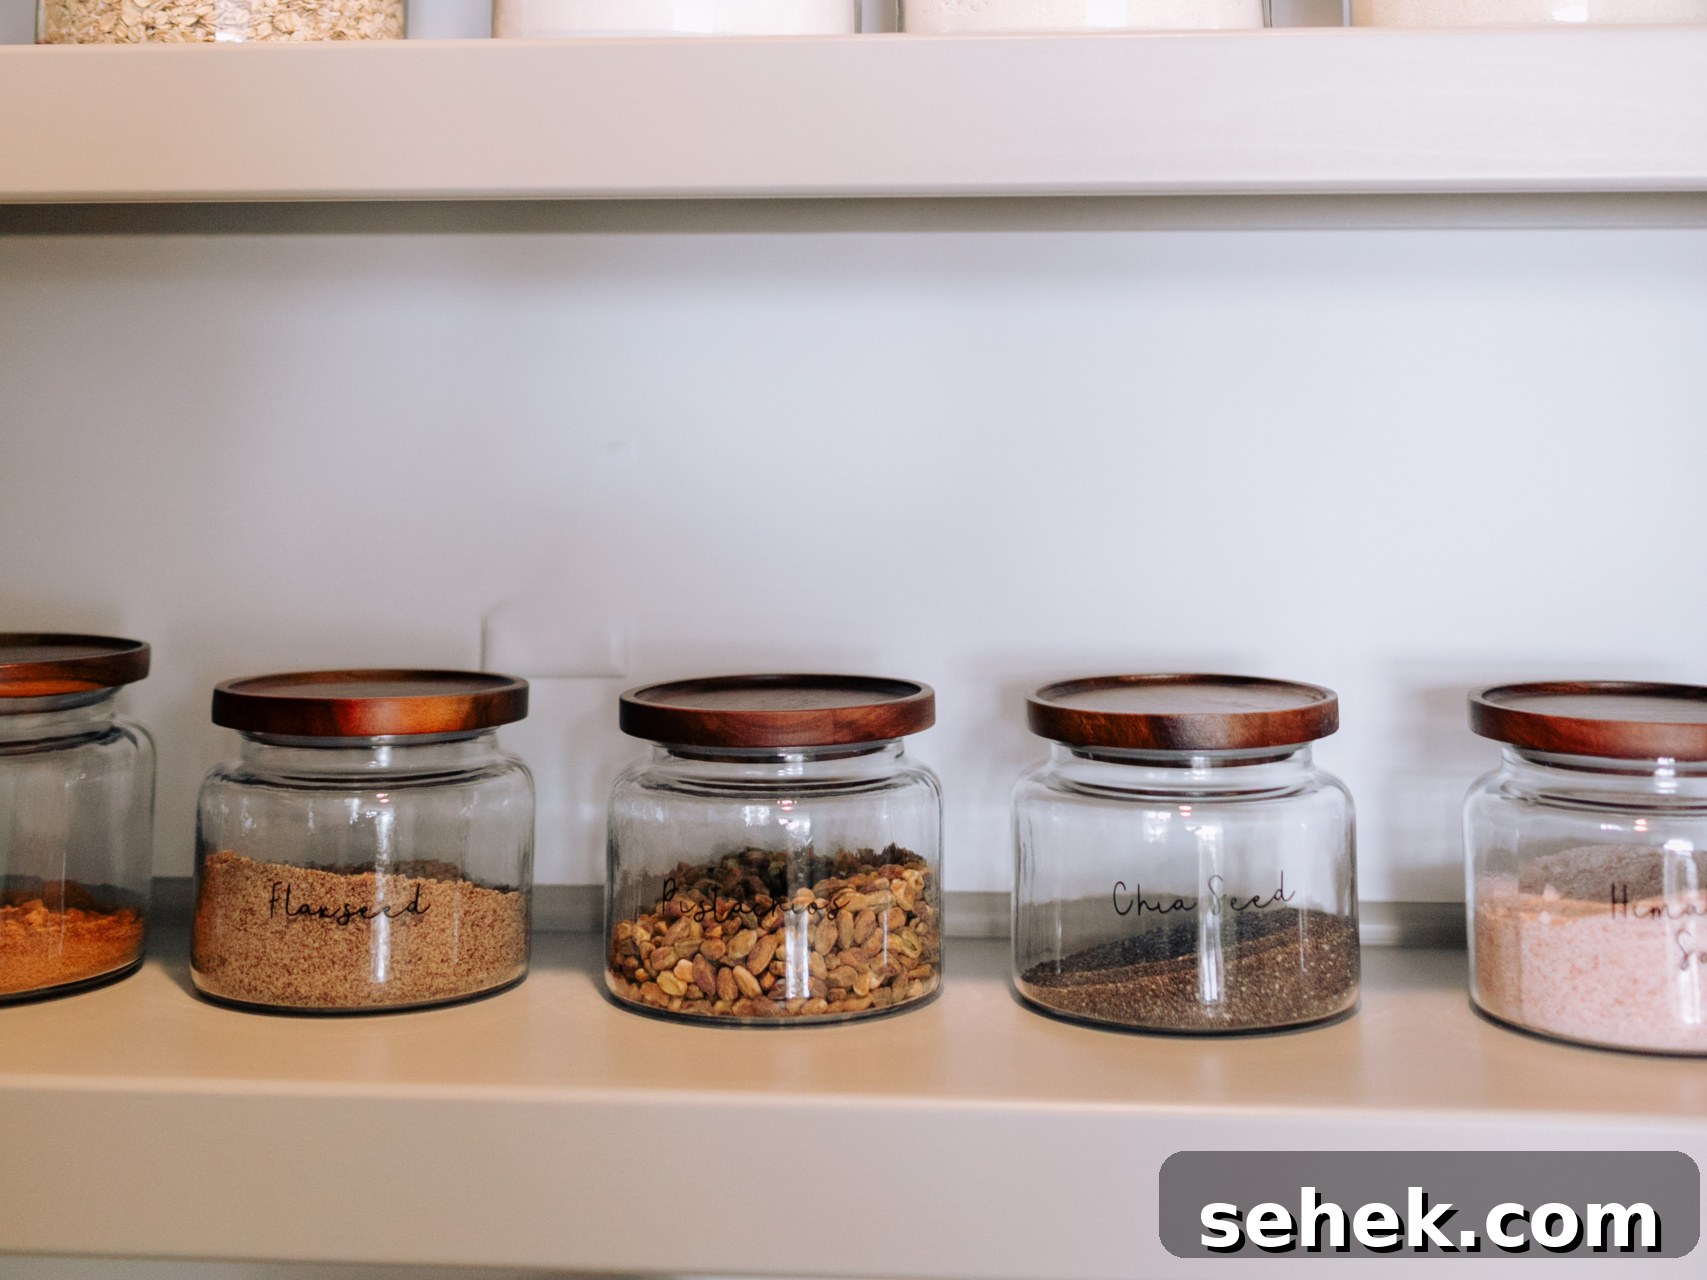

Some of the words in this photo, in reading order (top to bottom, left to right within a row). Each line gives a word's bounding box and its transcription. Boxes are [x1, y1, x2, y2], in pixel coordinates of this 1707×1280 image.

[268, 880, 432, 926] Flaxseed
[661, 876, 851, 924] Pistachios
[1112, 880, 1198, 917] Chia
[1207, 869, 1296, 916] Seed
[1610, 882, 1707, 921] Hima
